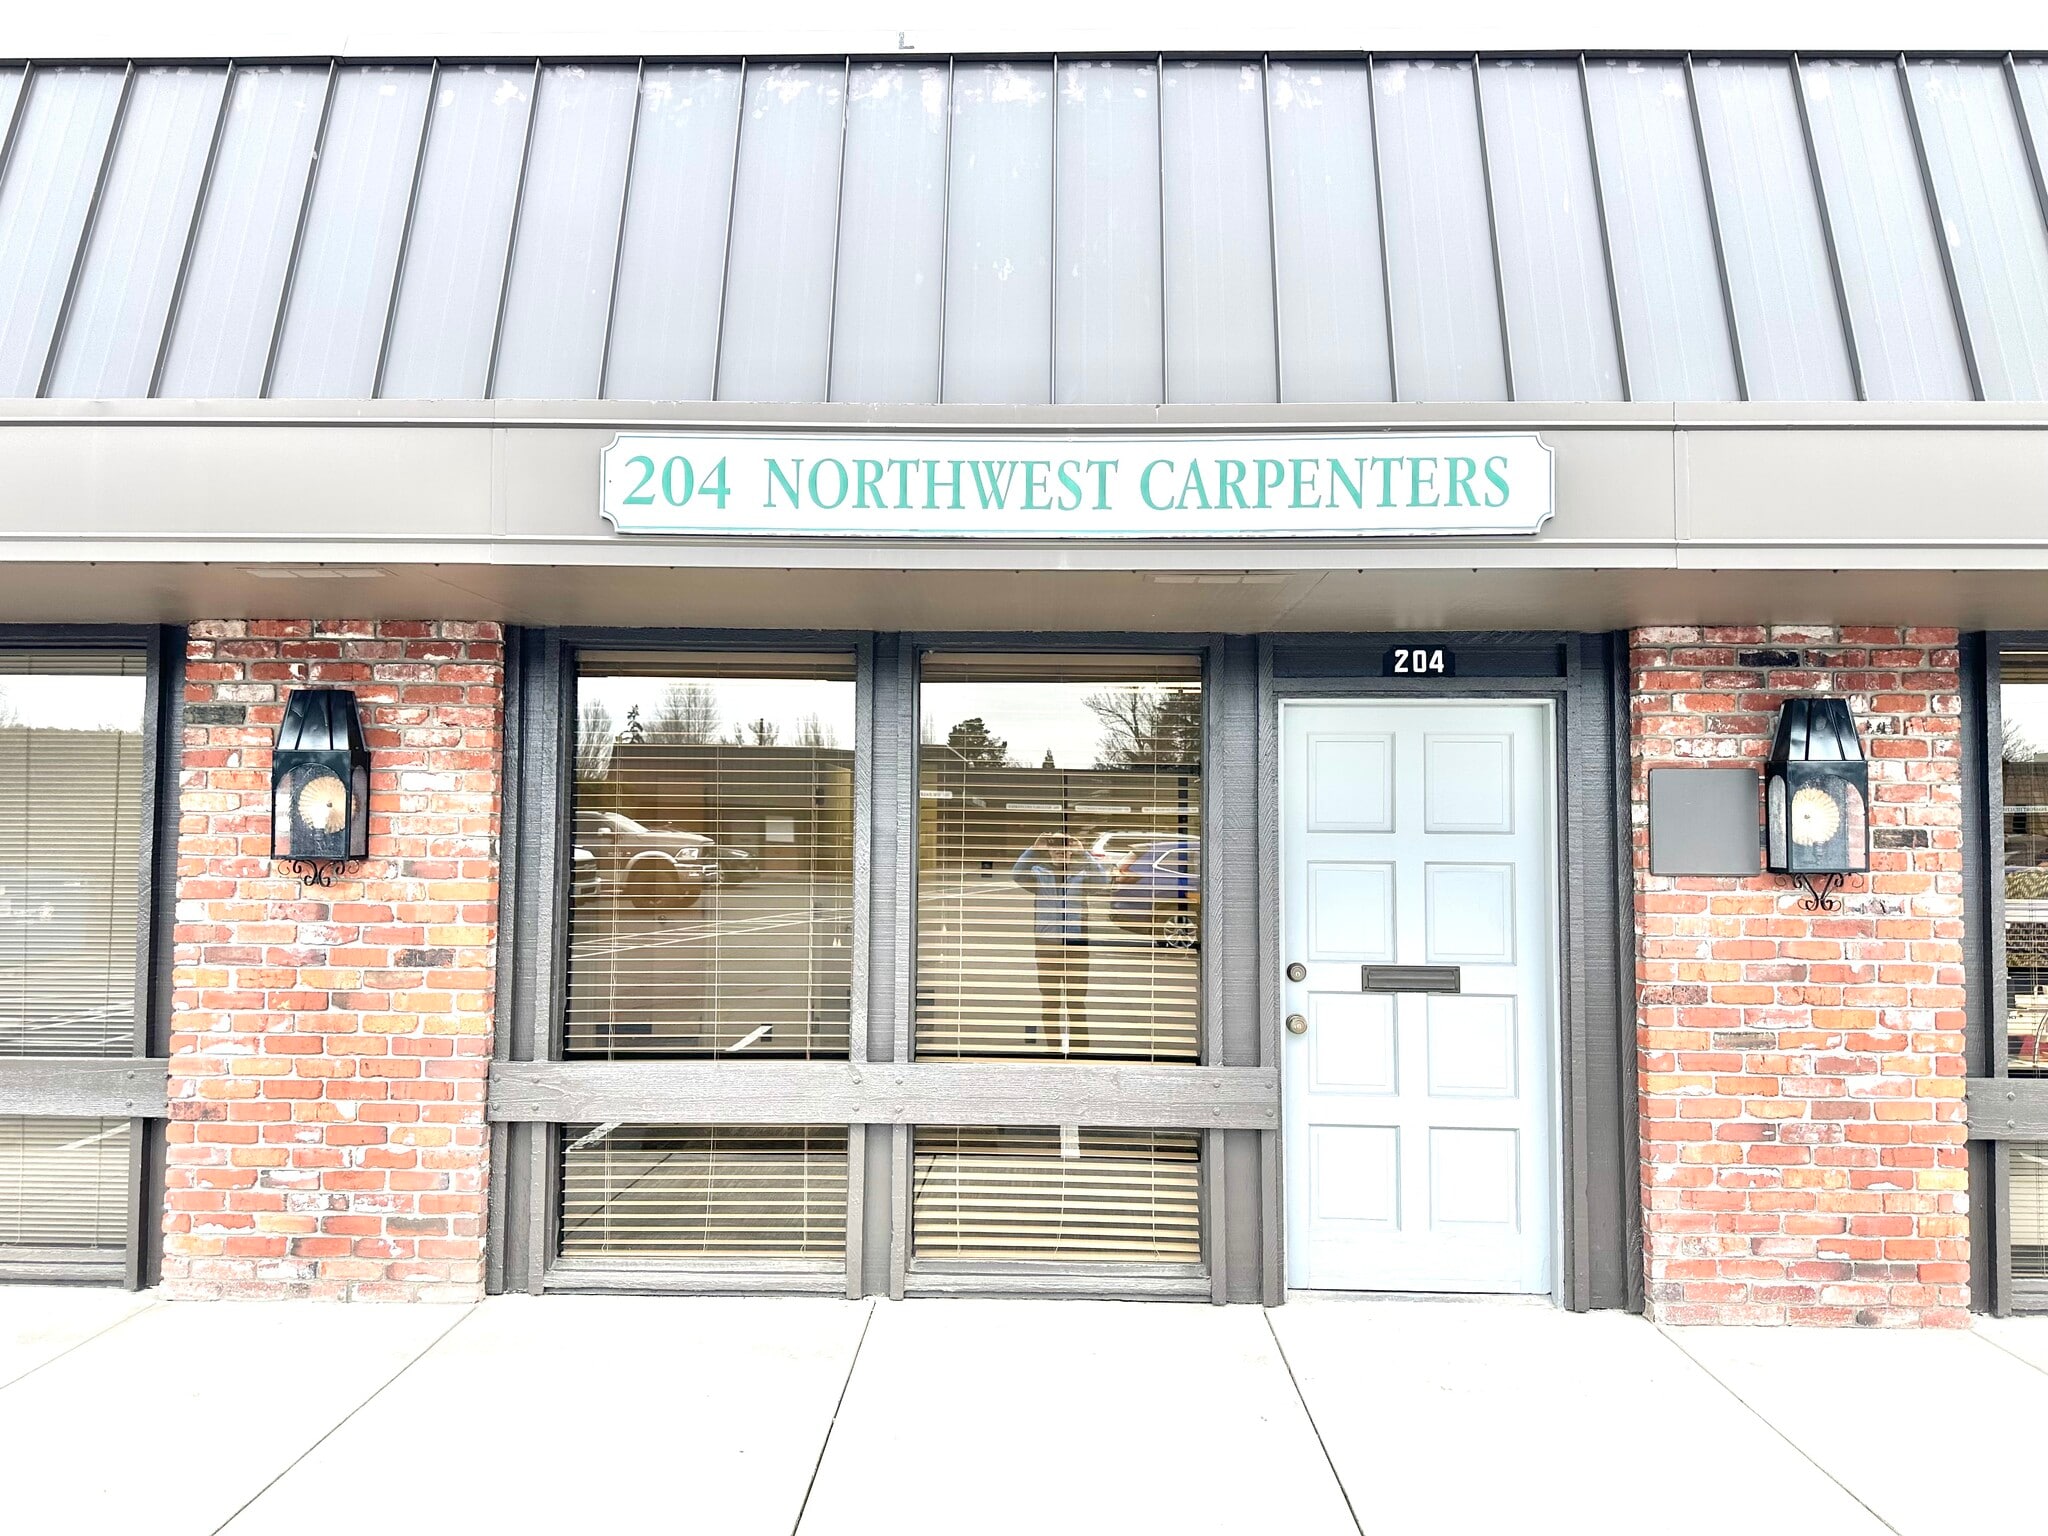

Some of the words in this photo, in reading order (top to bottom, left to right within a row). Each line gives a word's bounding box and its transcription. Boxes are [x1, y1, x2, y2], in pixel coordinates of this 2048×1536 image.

[623, 455, 731, 509] 204
[764, 458, 1119, 511] NORTHWEST
[1140, 456, 1510, 511] CARPENTERS
[1394, 649, 1445, 673] 204
